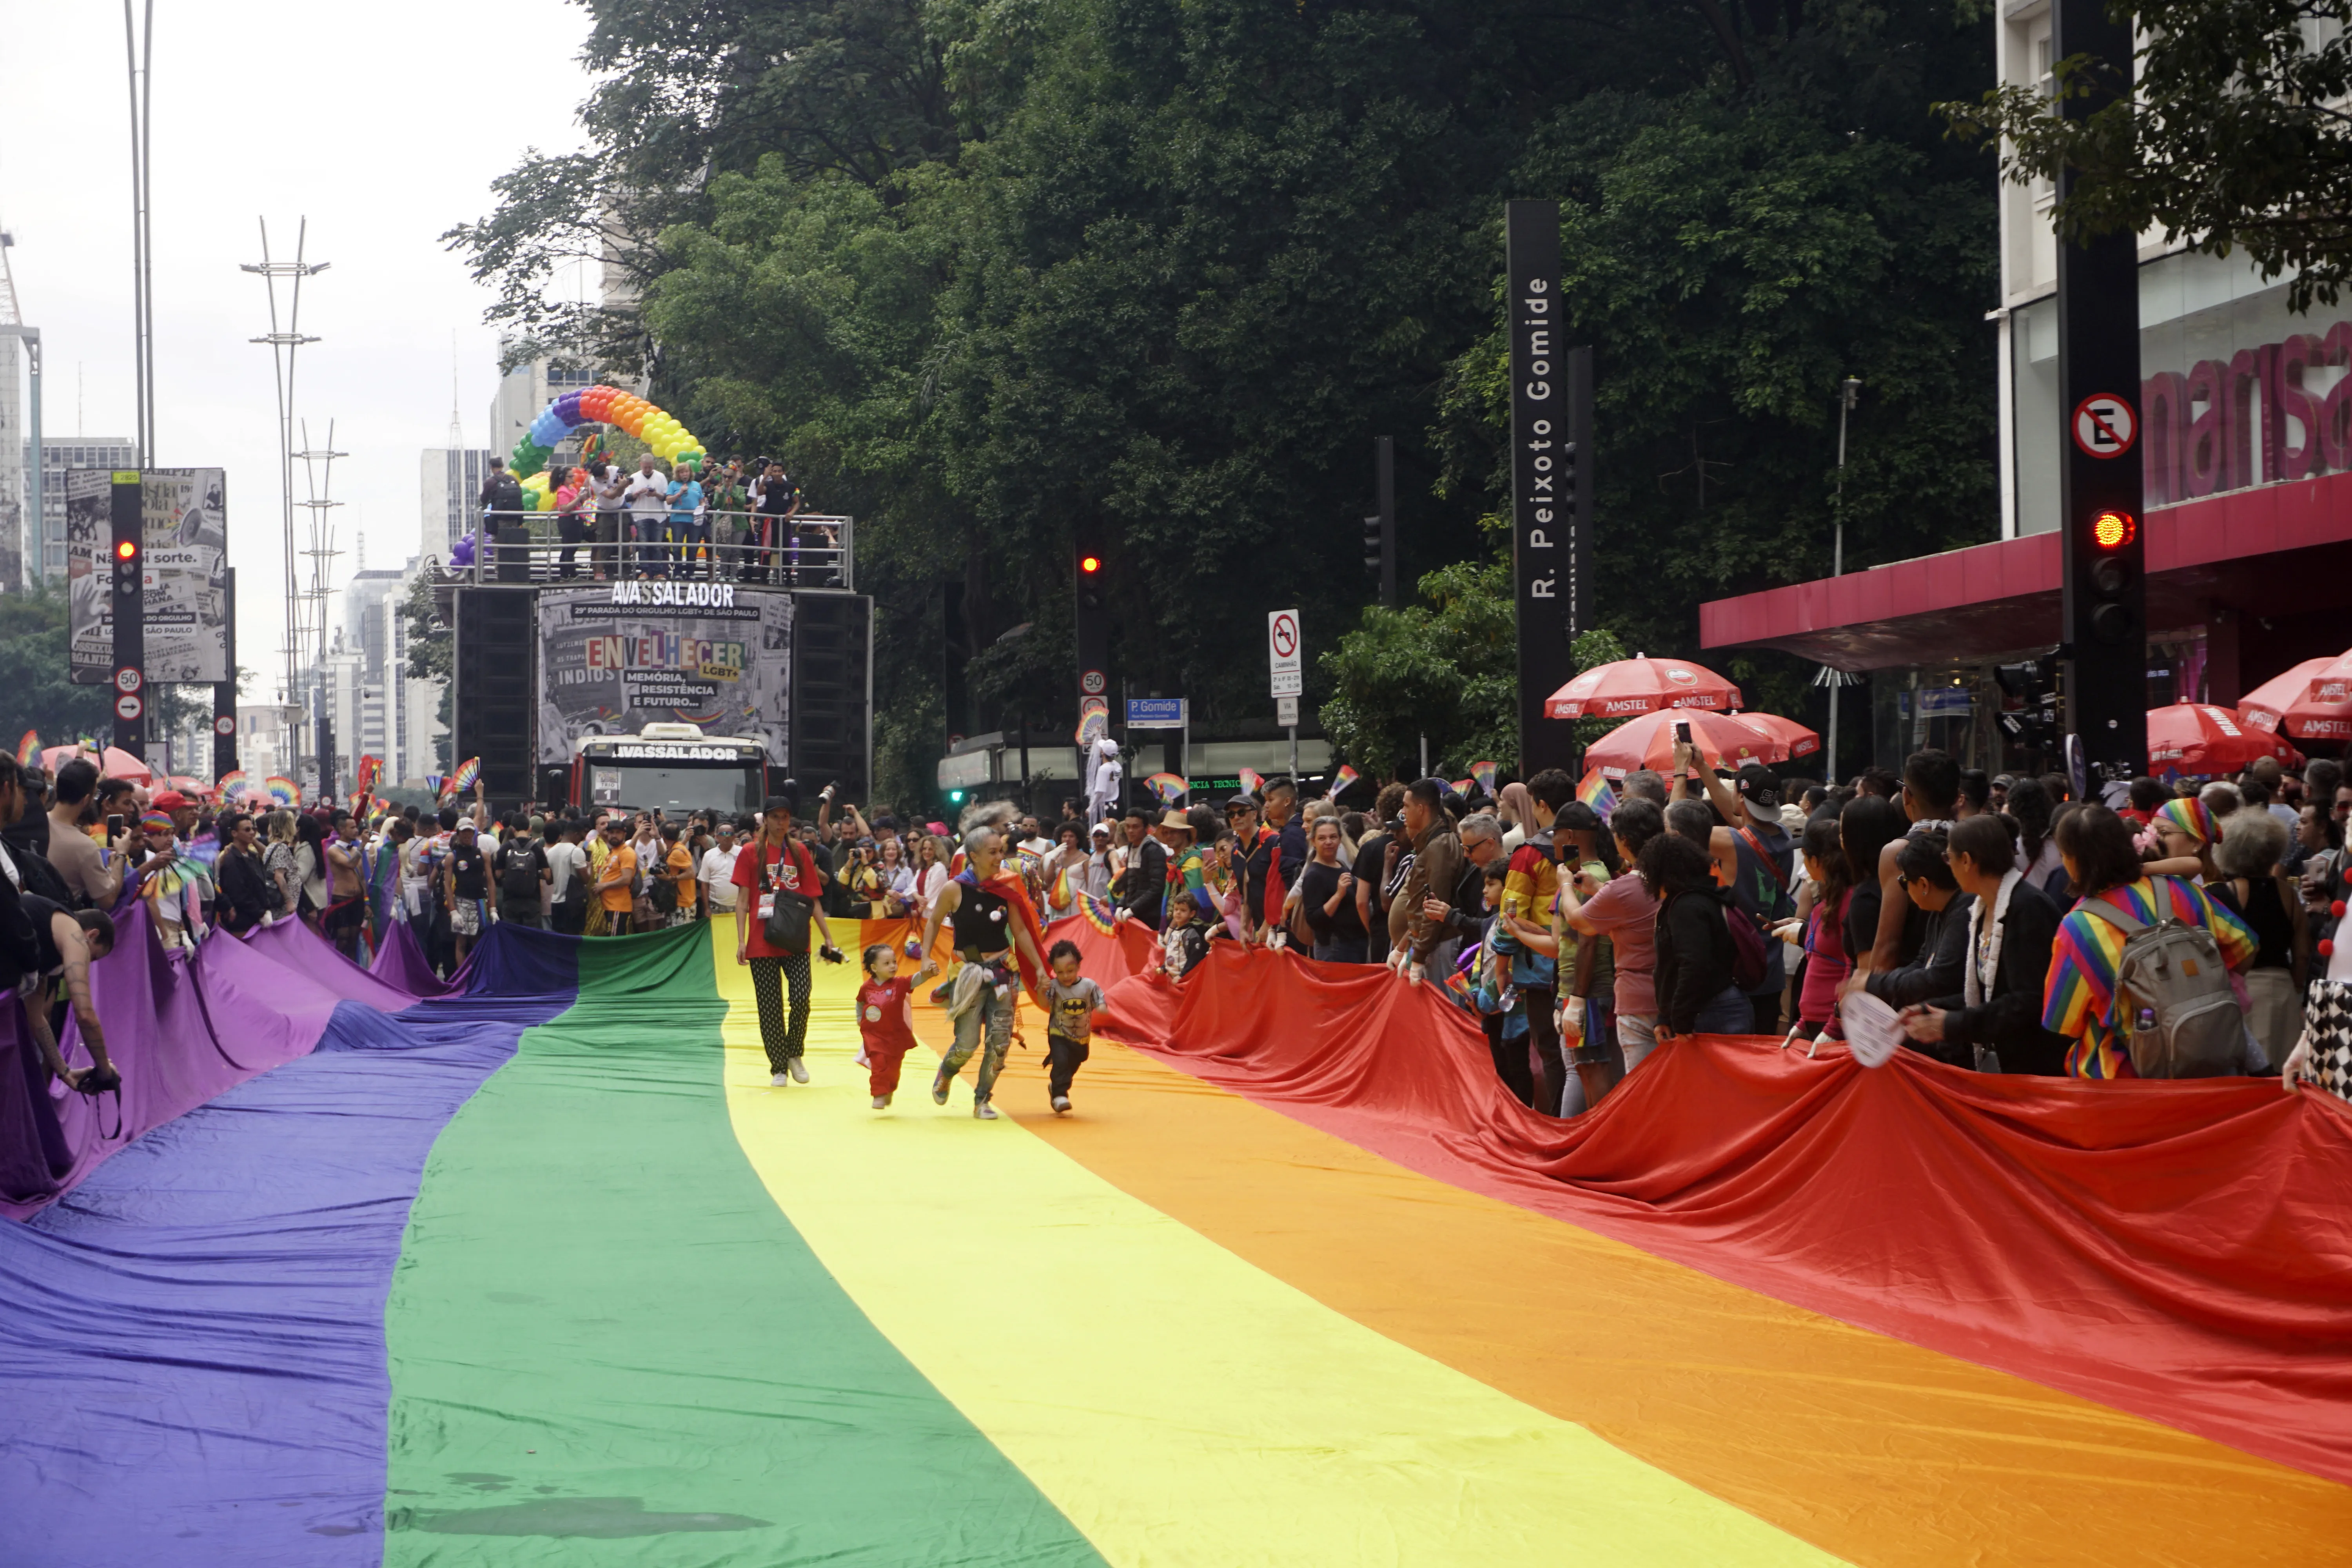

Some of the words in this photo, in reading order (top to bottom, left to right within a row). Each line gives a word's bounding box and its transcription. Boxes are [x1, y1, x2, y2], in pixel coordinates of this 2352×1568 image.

[1525, 278, 1550, 400] Gomide
[1529, 419, 1553, 547] Peixoto
[154, 552, 197, 563] sorte.
[1532, 569, 1555, 597] R.
[612, 581, 733, 607] AVASSALADOR
[716, 608, 732, 616] SÃO
[589, 635, 742, 668] ENVELHECER
[627, 671, 686, 683] MEMÓRIA,
[703, 667, 739, 677] LGBT+
[121, 673, 137, 684] 50
[1086, 675, 1102, 686] 50
[641, 684, 714, 695] RESISTÊNCIA
[2319, 683, 2345, 696] AMSTEL
[633, 697, 641, 705] E
[643, 697, 699, 707] FUTURO...
[1131, 702, 1138, 711] P.
[1140, 700, 1176, 712] Gomide
[1606, 699, 1649, 711] AMSTEL
[1681, 695, 1716, 706] AMSTEL
[1555, 703, 1579, 714] AMSTEL
[2200, 707, 2243, 736] BRAHMA
[612, 746, 738, 761] AVASSALADOR
[1213, 780, 1242, 788] TECNIC
[604, 789, 611, 800] 1
